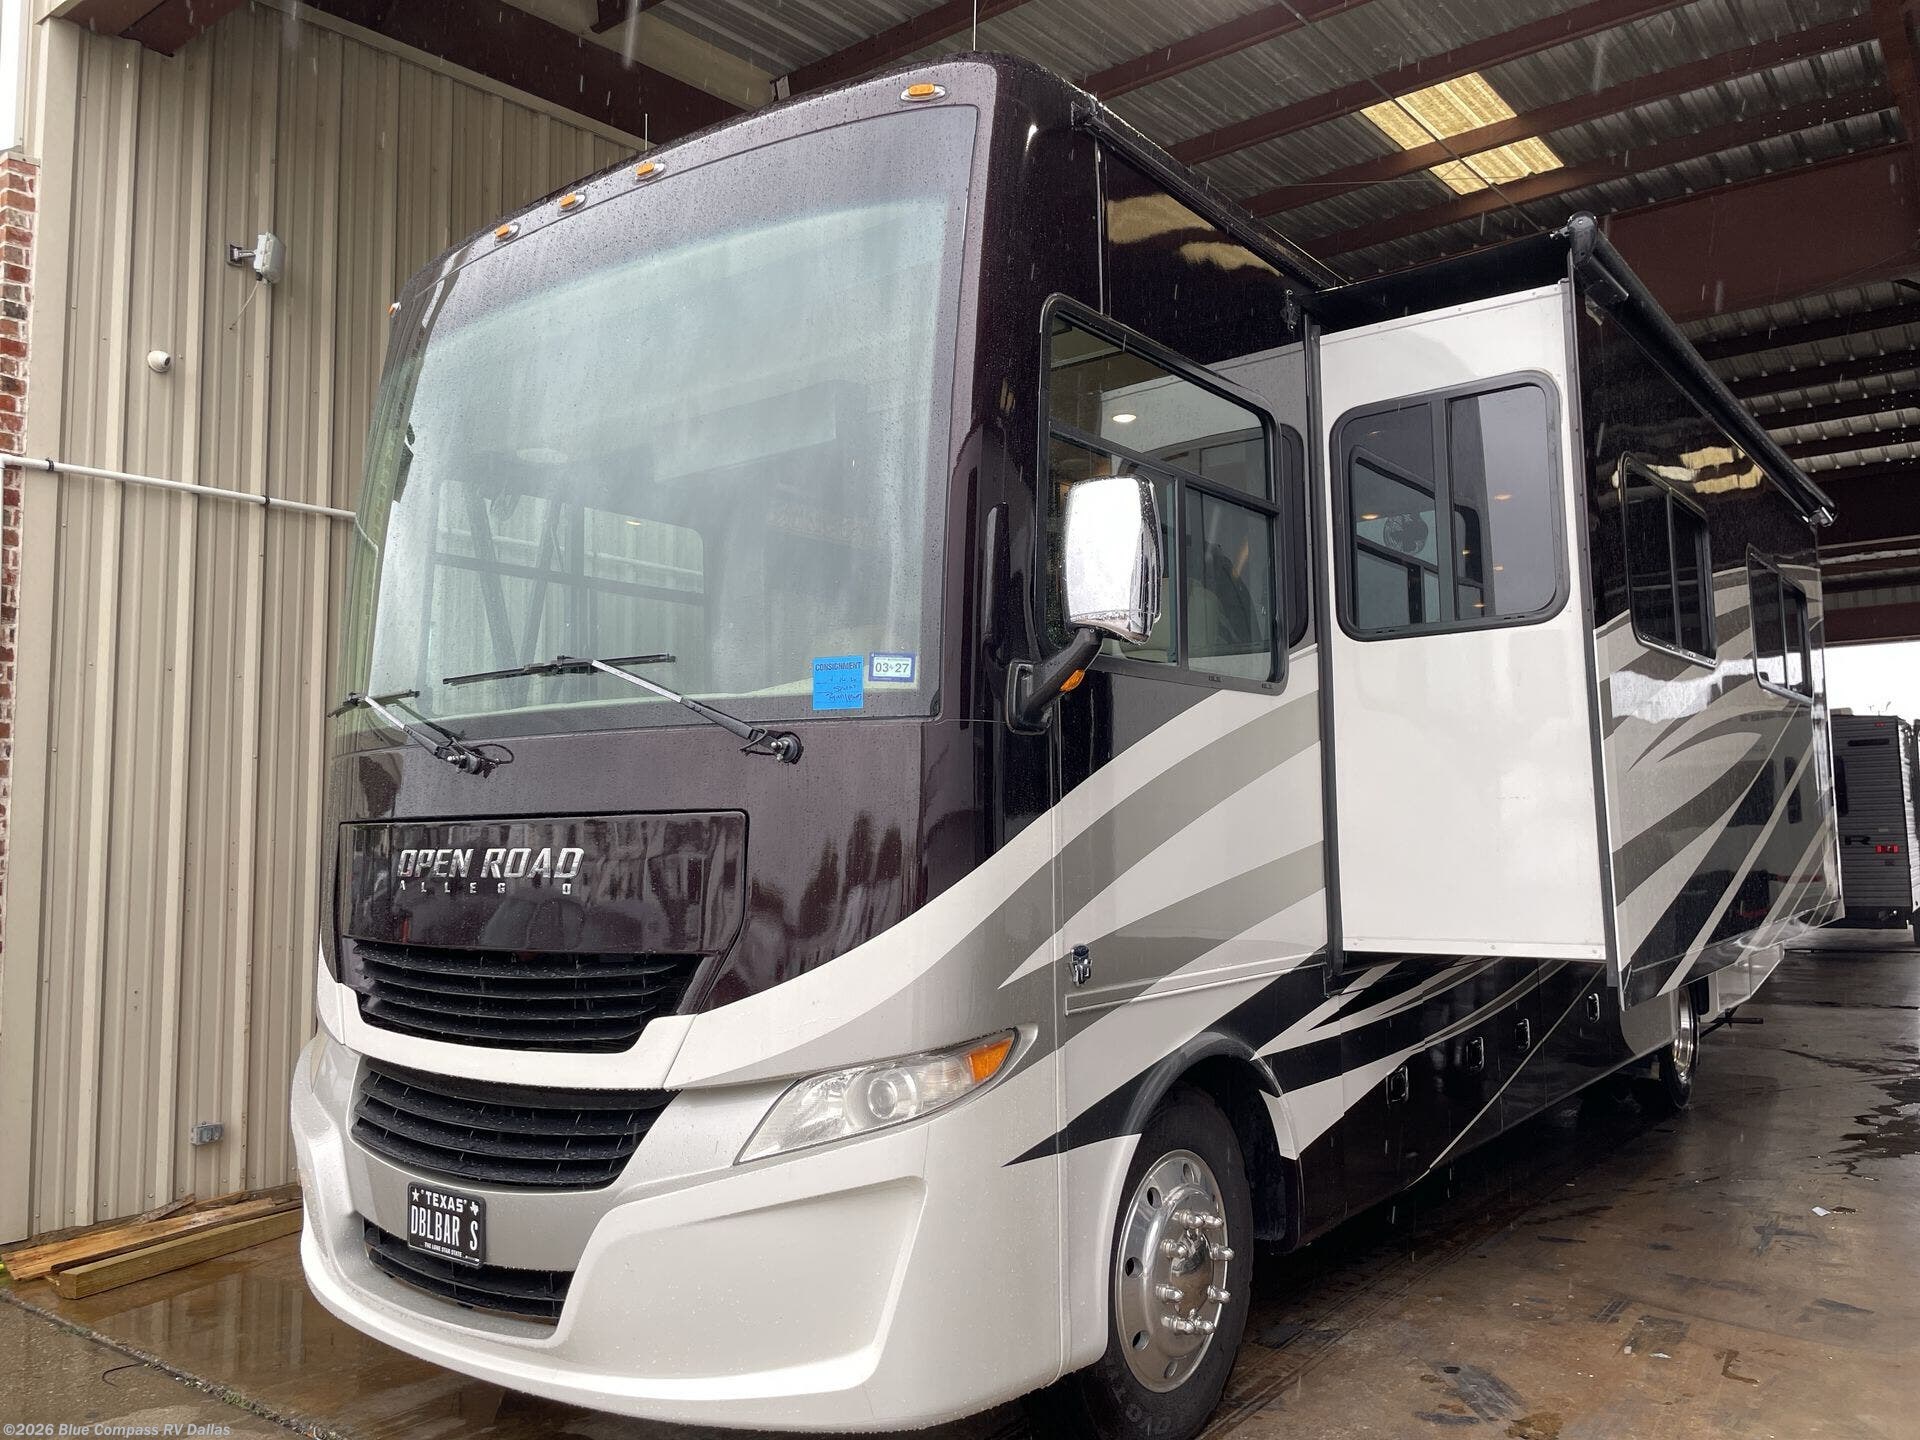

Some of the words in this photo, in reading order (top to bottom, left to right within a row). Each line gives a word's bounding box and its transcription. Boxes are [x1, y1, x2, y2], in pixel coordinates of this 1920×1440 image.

[815, 661, 862, 671] CONSIGNMENT
[398, 848, 474, 878] OPEN
[480, 847, 585, 879] ROAD
[400, 879, 572, 895] ALLEGO
[425, 1190, 464, 1213] TEXAS
[410, 1204, 460, 1247] DBLBAR
[469, 1220, 479, 1251] S
